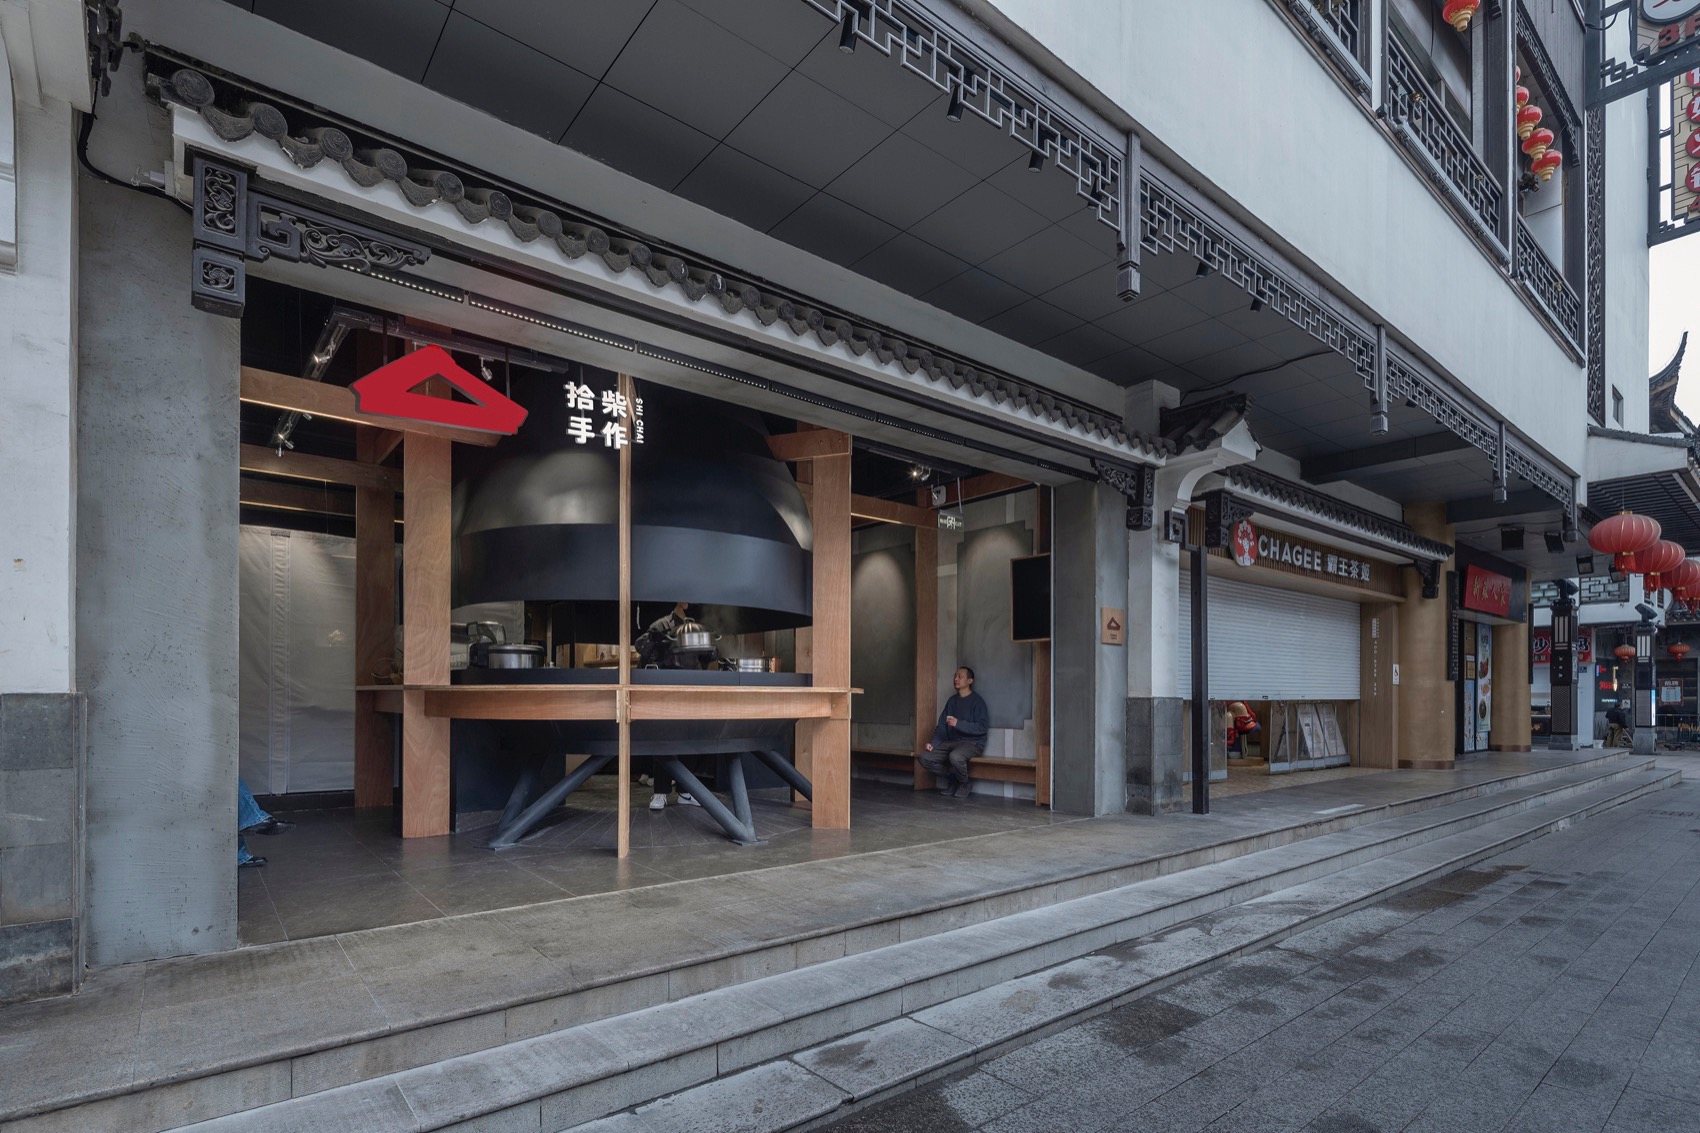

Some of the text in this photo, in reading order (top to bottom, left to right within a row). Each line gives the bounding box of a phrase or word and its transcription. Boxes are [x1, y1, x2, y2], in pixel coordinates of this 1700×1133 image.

[564, 381, 628, 418] 拾柴
[567, 416, 628, 450] 手作
[635, 397, 644, 444] SHI CHAI
[1258, 534, 1322, 571] CHAGEE
